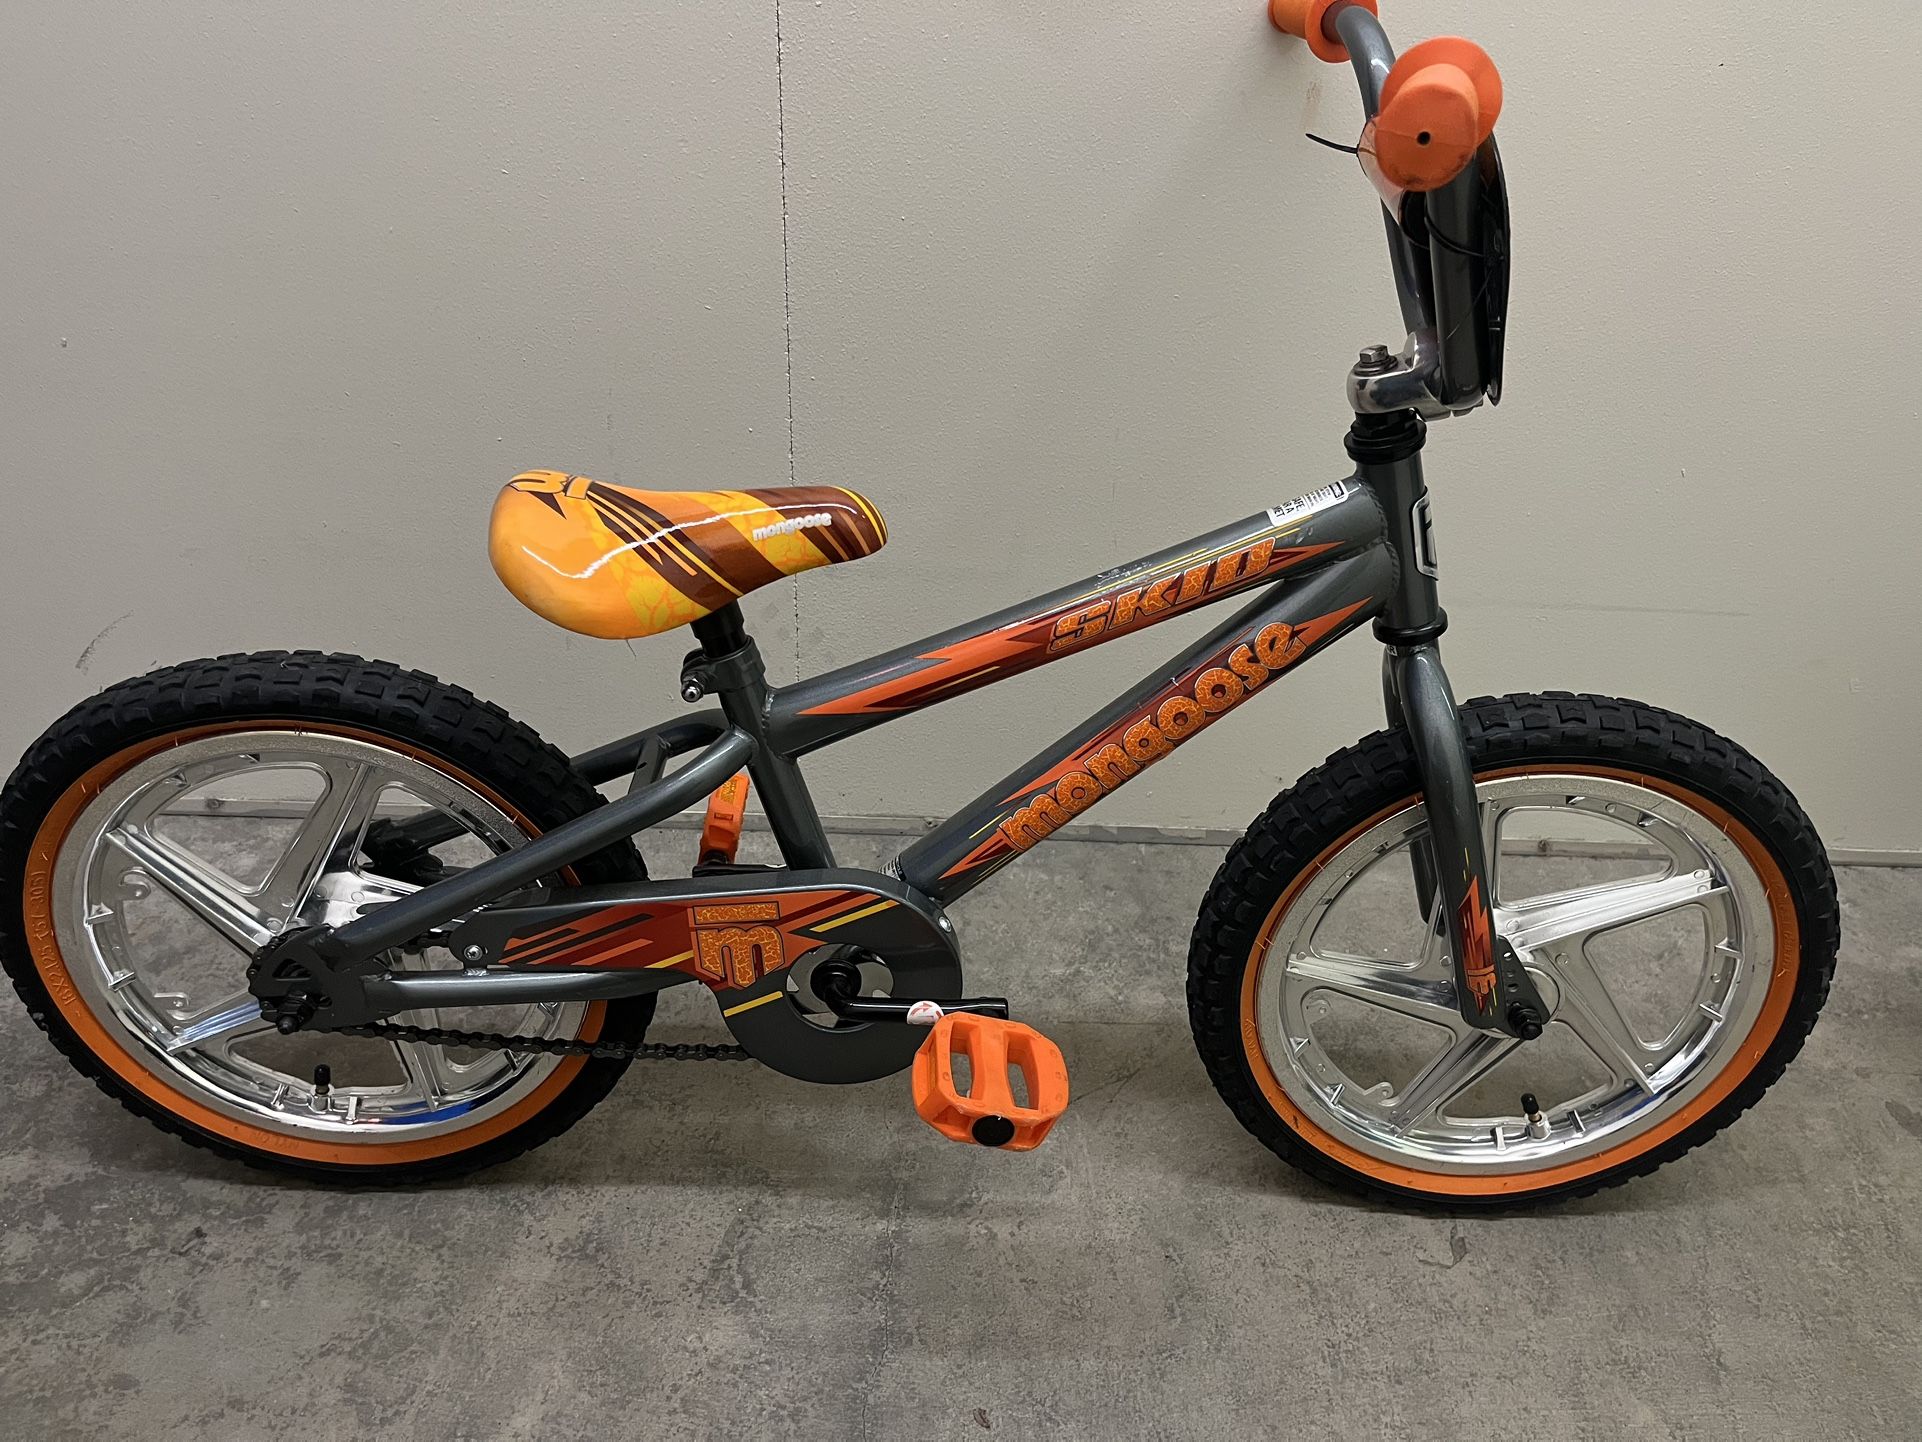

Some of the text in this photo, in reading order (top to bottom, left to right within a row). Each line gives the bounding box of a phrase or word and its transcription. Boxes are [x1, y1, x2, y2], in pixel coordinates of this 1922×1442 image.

[752, 512, 833, 541] mongoose
[1050, 536, 1276, 651] SKID
[998, 621, 1307, 851] mongoose
